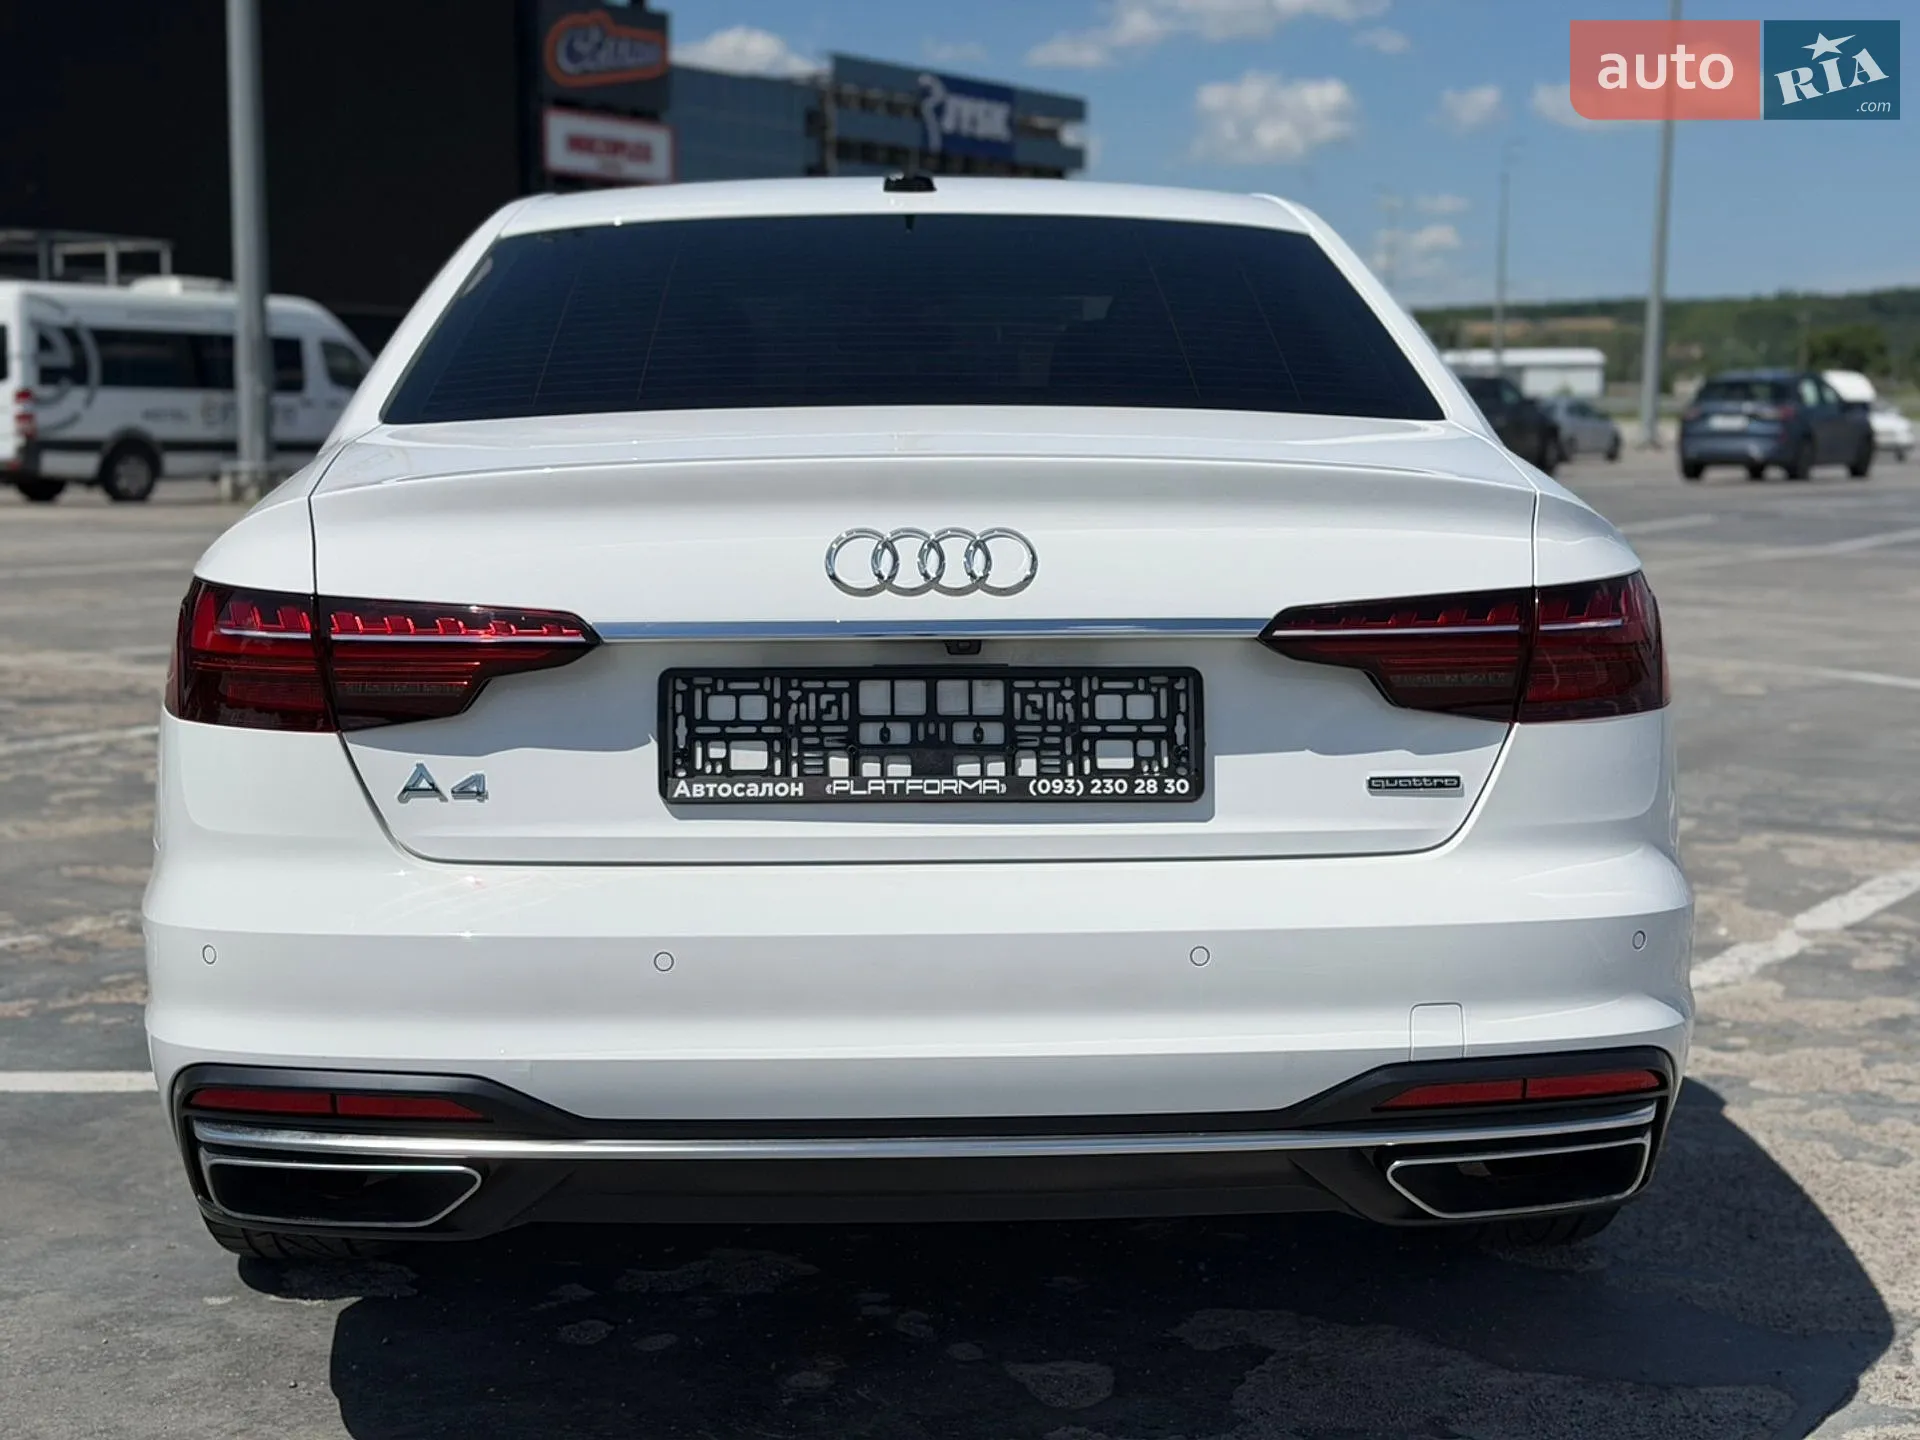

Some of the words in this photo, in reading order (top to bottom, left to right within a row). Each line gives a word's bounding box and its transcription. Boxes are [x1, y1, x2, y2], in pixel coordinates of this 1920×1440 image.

[397, 762, 489, 804] A4
[672, 780, 804, 798] Автосалон
[1029, 779, 1084, 796] (093)
[1090, 779, 1128, 794] 230
[1134, 779, 1158, 794] 28
[1164, 779, 1190, 794] 30
[1371, 777, 1458, 789] quattro
